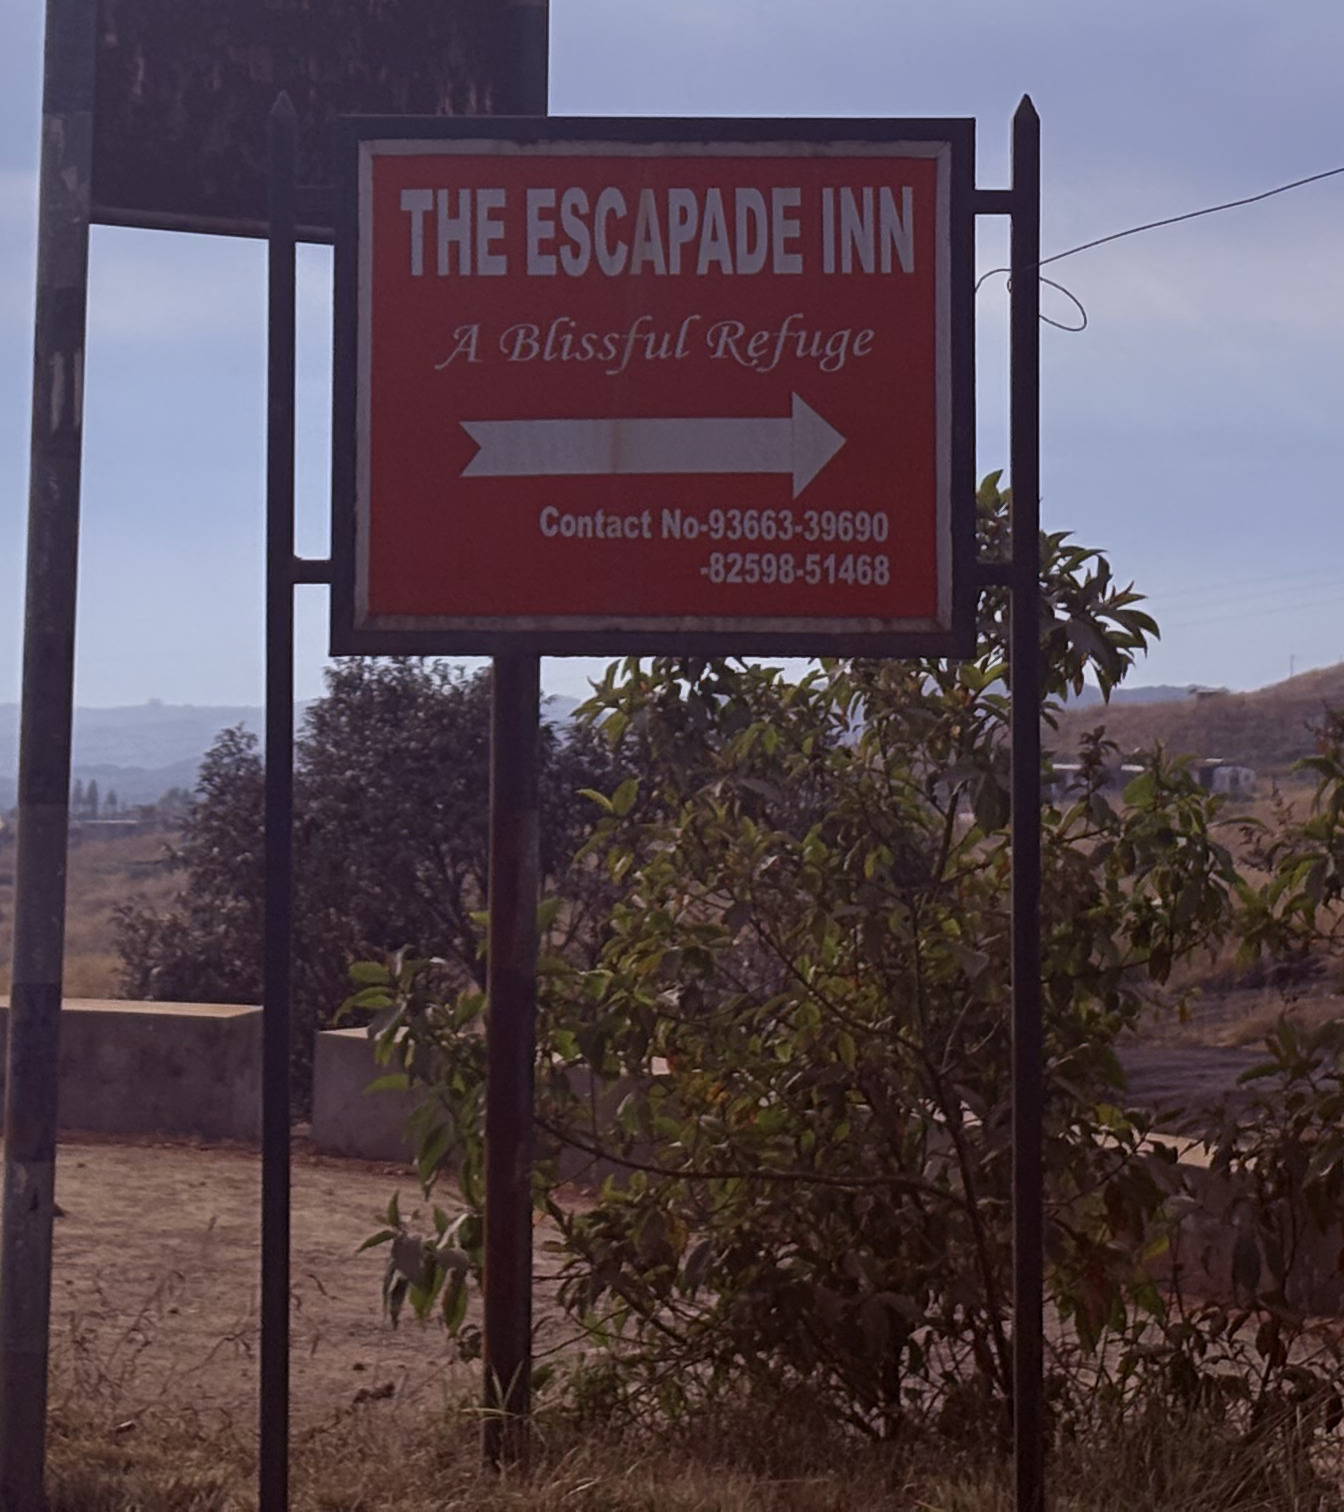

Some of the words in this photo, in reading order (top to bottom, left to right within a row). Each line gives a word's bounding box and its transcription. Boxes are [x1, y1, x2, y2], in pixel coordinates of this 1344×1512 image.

[400, 188, 508, 278] THE
[526, 186, 804, 277] ESCAPADE
[822, 186, 916, 275] INN
[434, 323, 484, 371] A
[499, 315, 702, 376] Blissful
[706, 314, 876, 373] Refuge
[540, 505, 653, 541] Contact
[700, 554, 891, 586] -82598-51468
